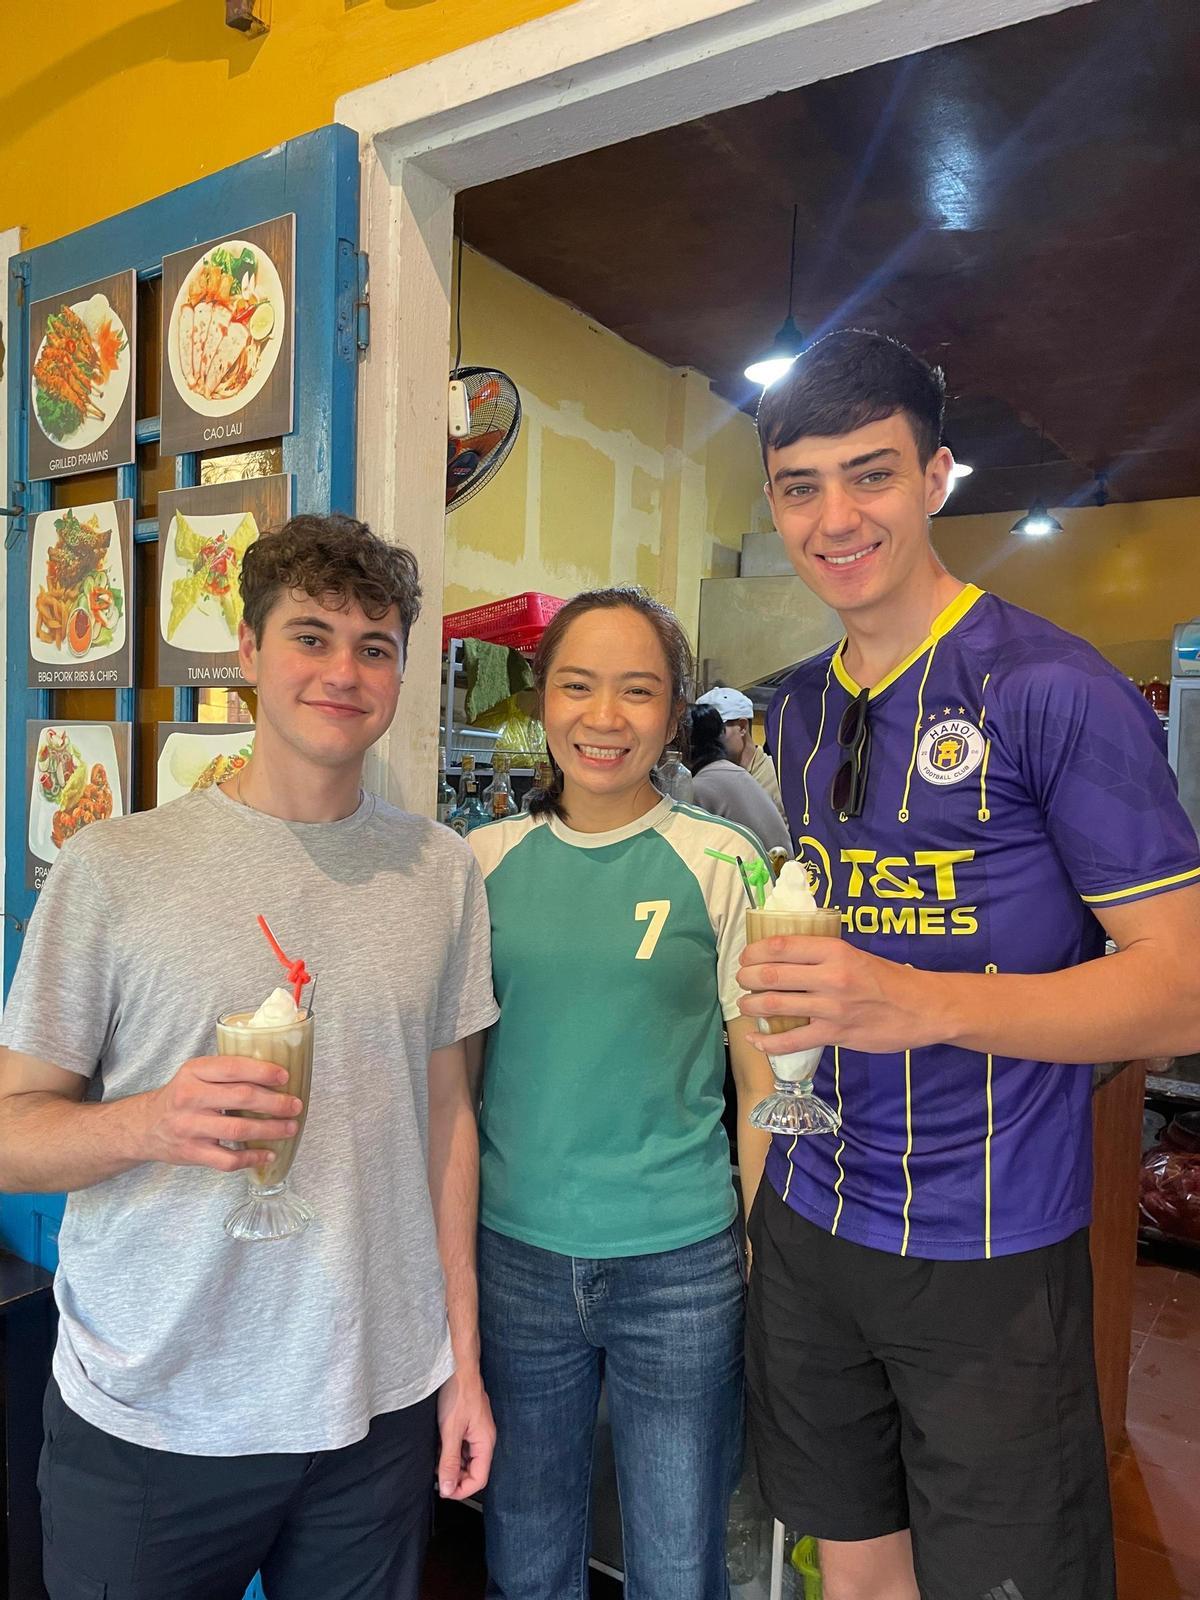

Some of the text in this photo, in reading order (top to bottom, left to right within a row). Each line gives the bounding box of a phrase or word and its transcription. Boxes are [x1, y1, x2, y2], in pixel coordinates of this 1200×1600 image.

[203, 422, 243, 441] CAO LAU
[49, 449, 109, 471] GRILLED PRAWNS
[38, 670, 118, 682] BBQ PORK RIBS & CHIPS
[188, 666, 245, 679] TUNA WONTO
[929, 723, 975, 740] HANOI
[923, 765, 970, 780] FOOTBALL CLUB
[35, 866, 50, 878] PRA
[840, 849, 976, 901] T&T
[834, 905, 978, 935] HOMES
[634, 899, 671, 960] 7
